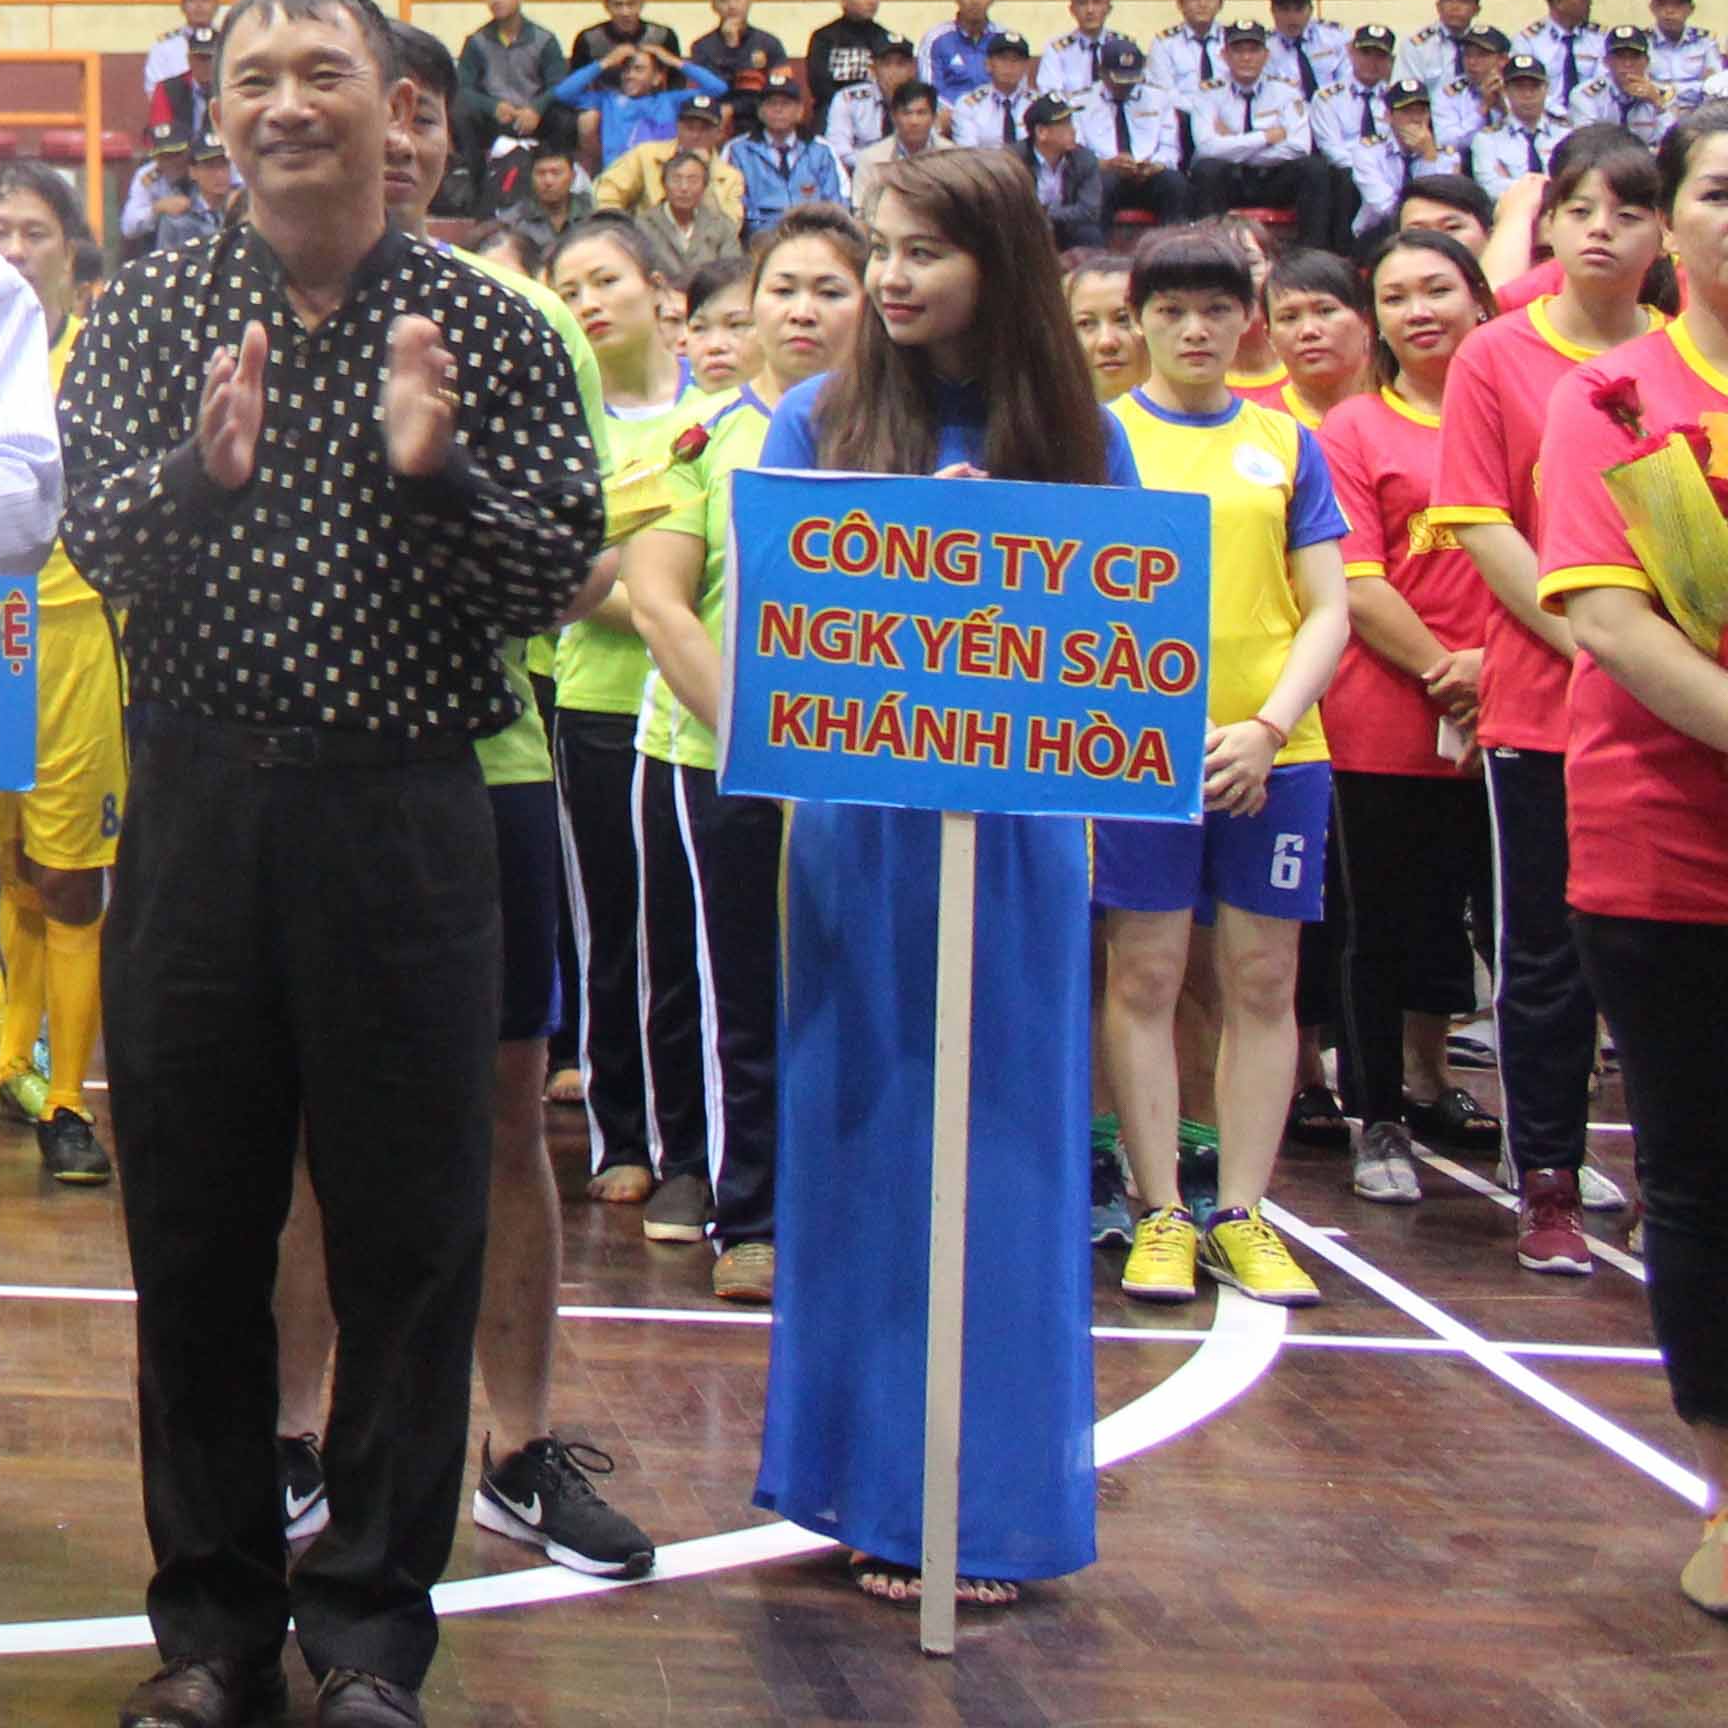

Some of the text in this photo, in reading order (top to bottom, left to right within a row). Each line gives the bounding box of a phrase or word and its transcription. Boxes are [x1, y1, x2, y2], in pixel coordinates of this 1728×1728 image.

[788, 509, 1181, 604] CÔNG TY CP
[757, 602, 1201, 696] NGK YẾN SÀO
[768, 692, 1177, 786] KHÁNH HÒA
[100, 792, 120, 838] 8
[1270, 832, 1305, 889] 6
